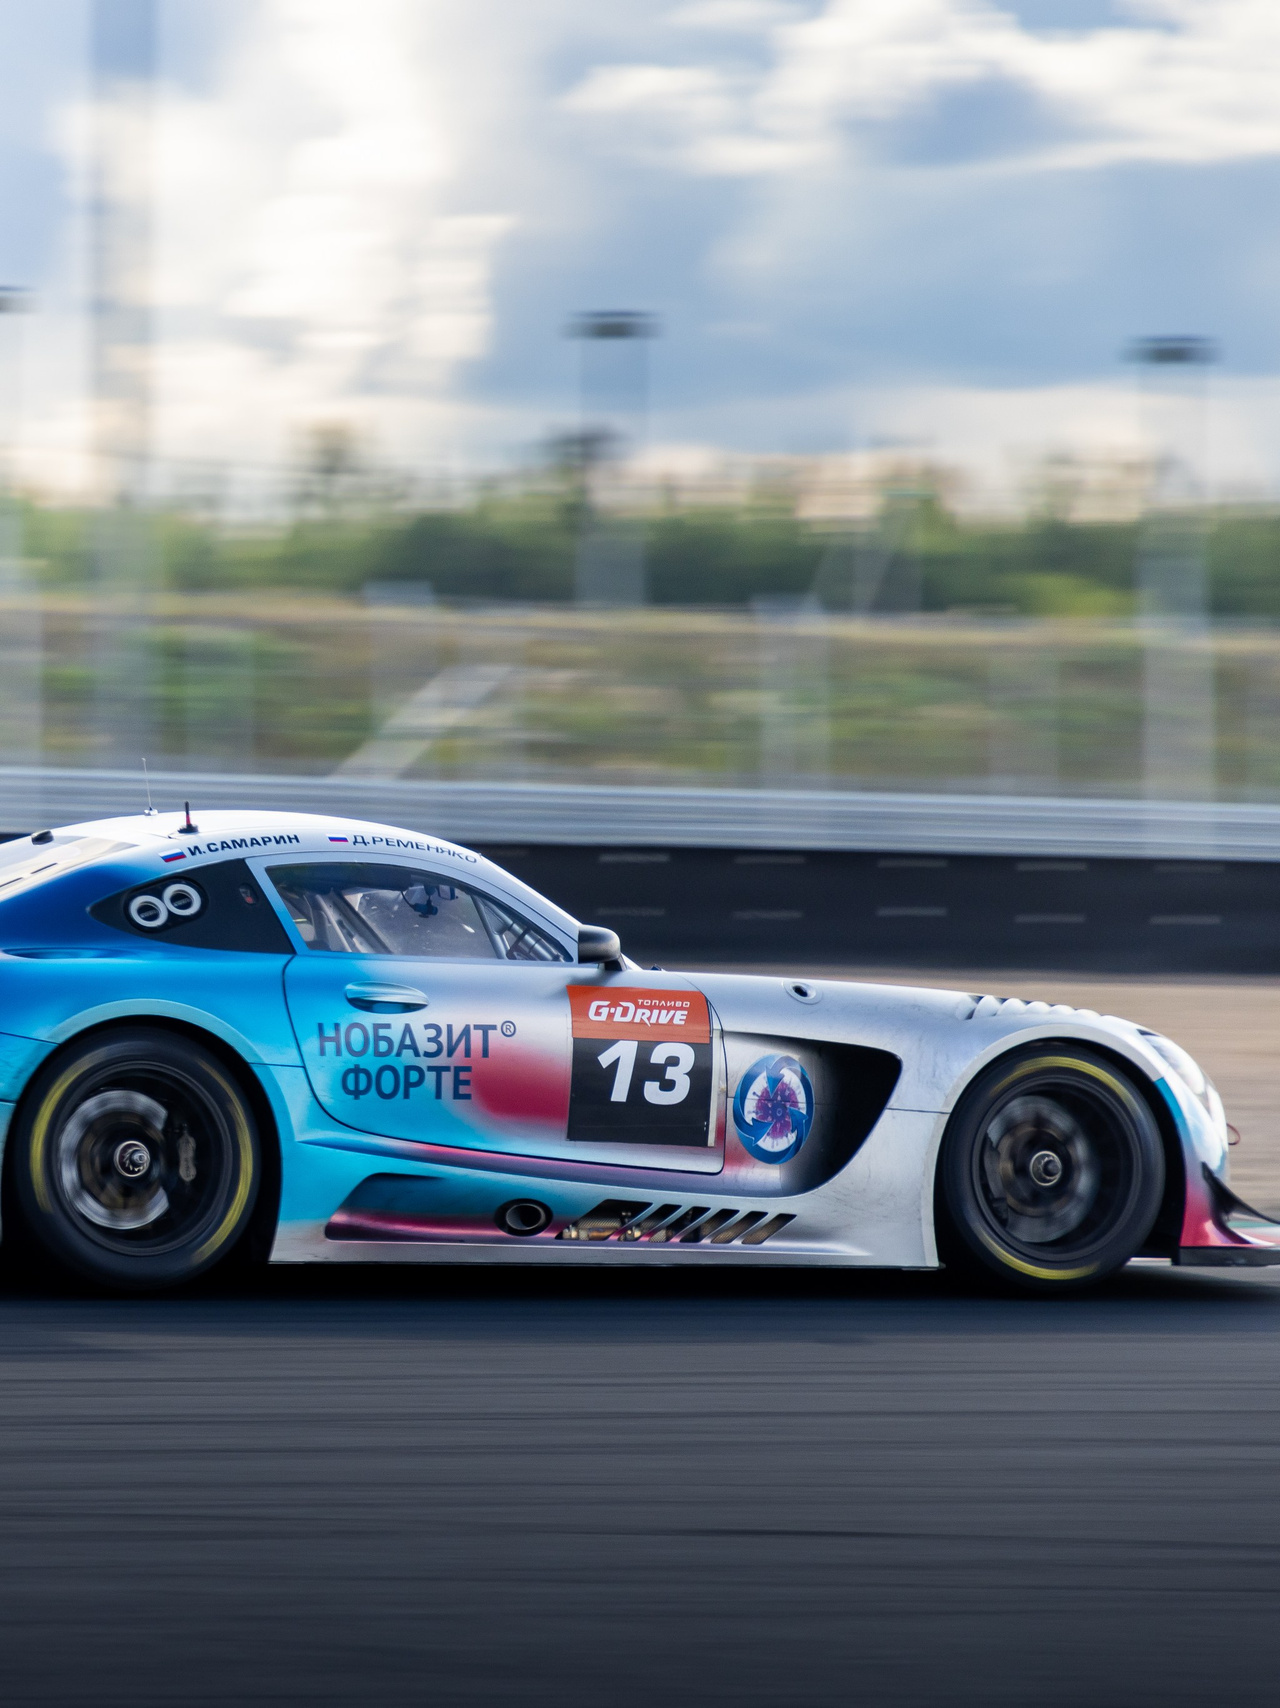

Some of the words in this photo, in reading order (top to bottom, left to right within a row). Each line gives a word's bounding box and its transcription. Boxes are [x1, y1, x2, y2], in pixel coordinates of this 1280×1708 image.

[637, 999, 690, 1008] ТОПЛИВО
[341, 1064, 472, 1100] ФОРТЕ
[597, 1040, 695, 1105] 13
